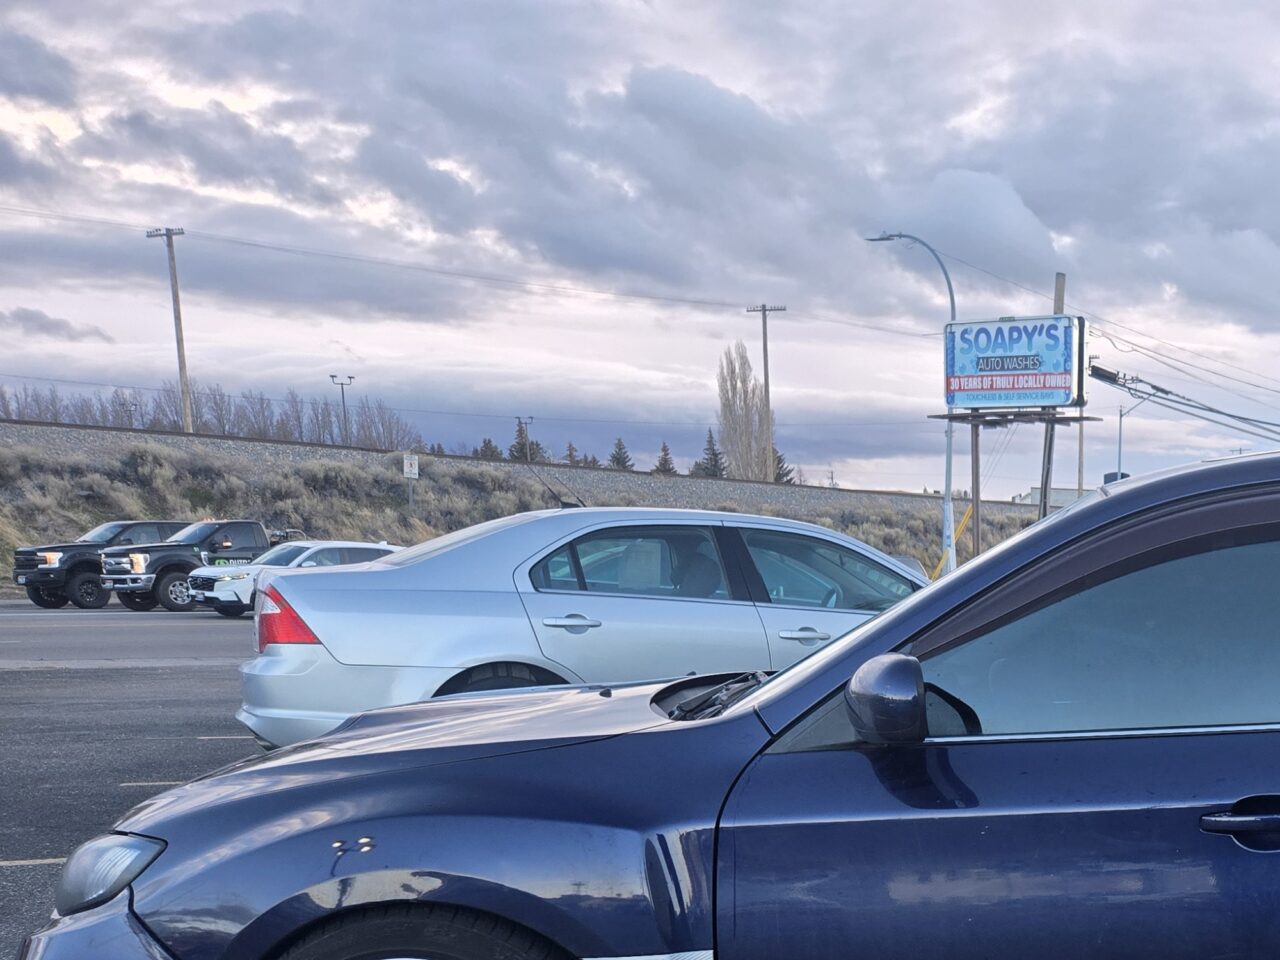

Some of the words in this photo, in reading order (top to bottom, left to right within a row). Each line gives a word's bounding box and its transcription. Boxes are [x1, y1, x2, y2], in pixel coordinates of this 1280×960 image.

[959, 323, 1060, 355] SOAPY'S
[978, 358, 1002, 371] AUTO
[1003, 356, 1040, 370] WASHES
[950, 378, 959, 390] 30
[960, 377, 982, 390] YEARS
[983, 376, 992, 389] OF
[993, 375, 1014, 389] TRULY
[1015, 375, 1045, 388] LOCALLY
[1045, 374, 1071, 387] OWNED
